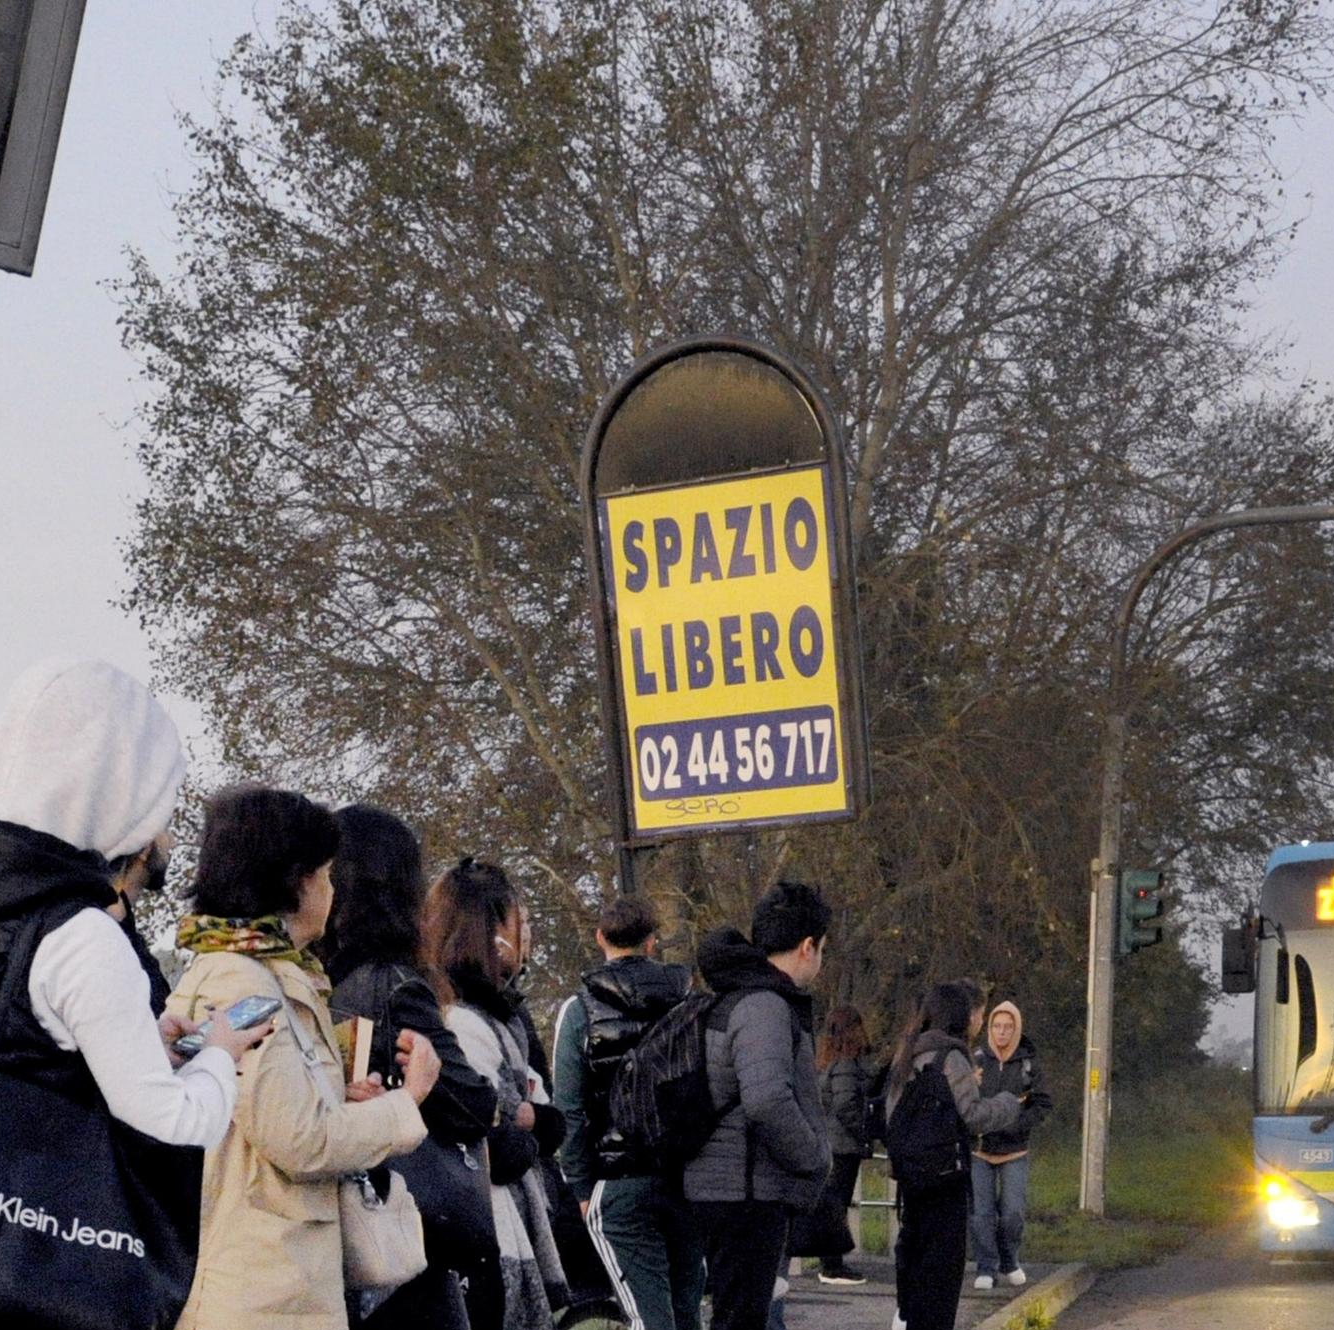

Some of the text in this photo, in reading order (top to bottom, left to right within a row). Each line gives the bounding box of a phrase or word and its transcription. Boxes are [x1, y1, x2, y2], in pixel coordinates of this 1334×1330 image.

[623, 497, 818, 593] SPAZIO
[630, 604, 824, 696] LIBERO
[640, 718, 833, 792] 02 44 56 717
[61, 1218, 145, 1258] Jeans
